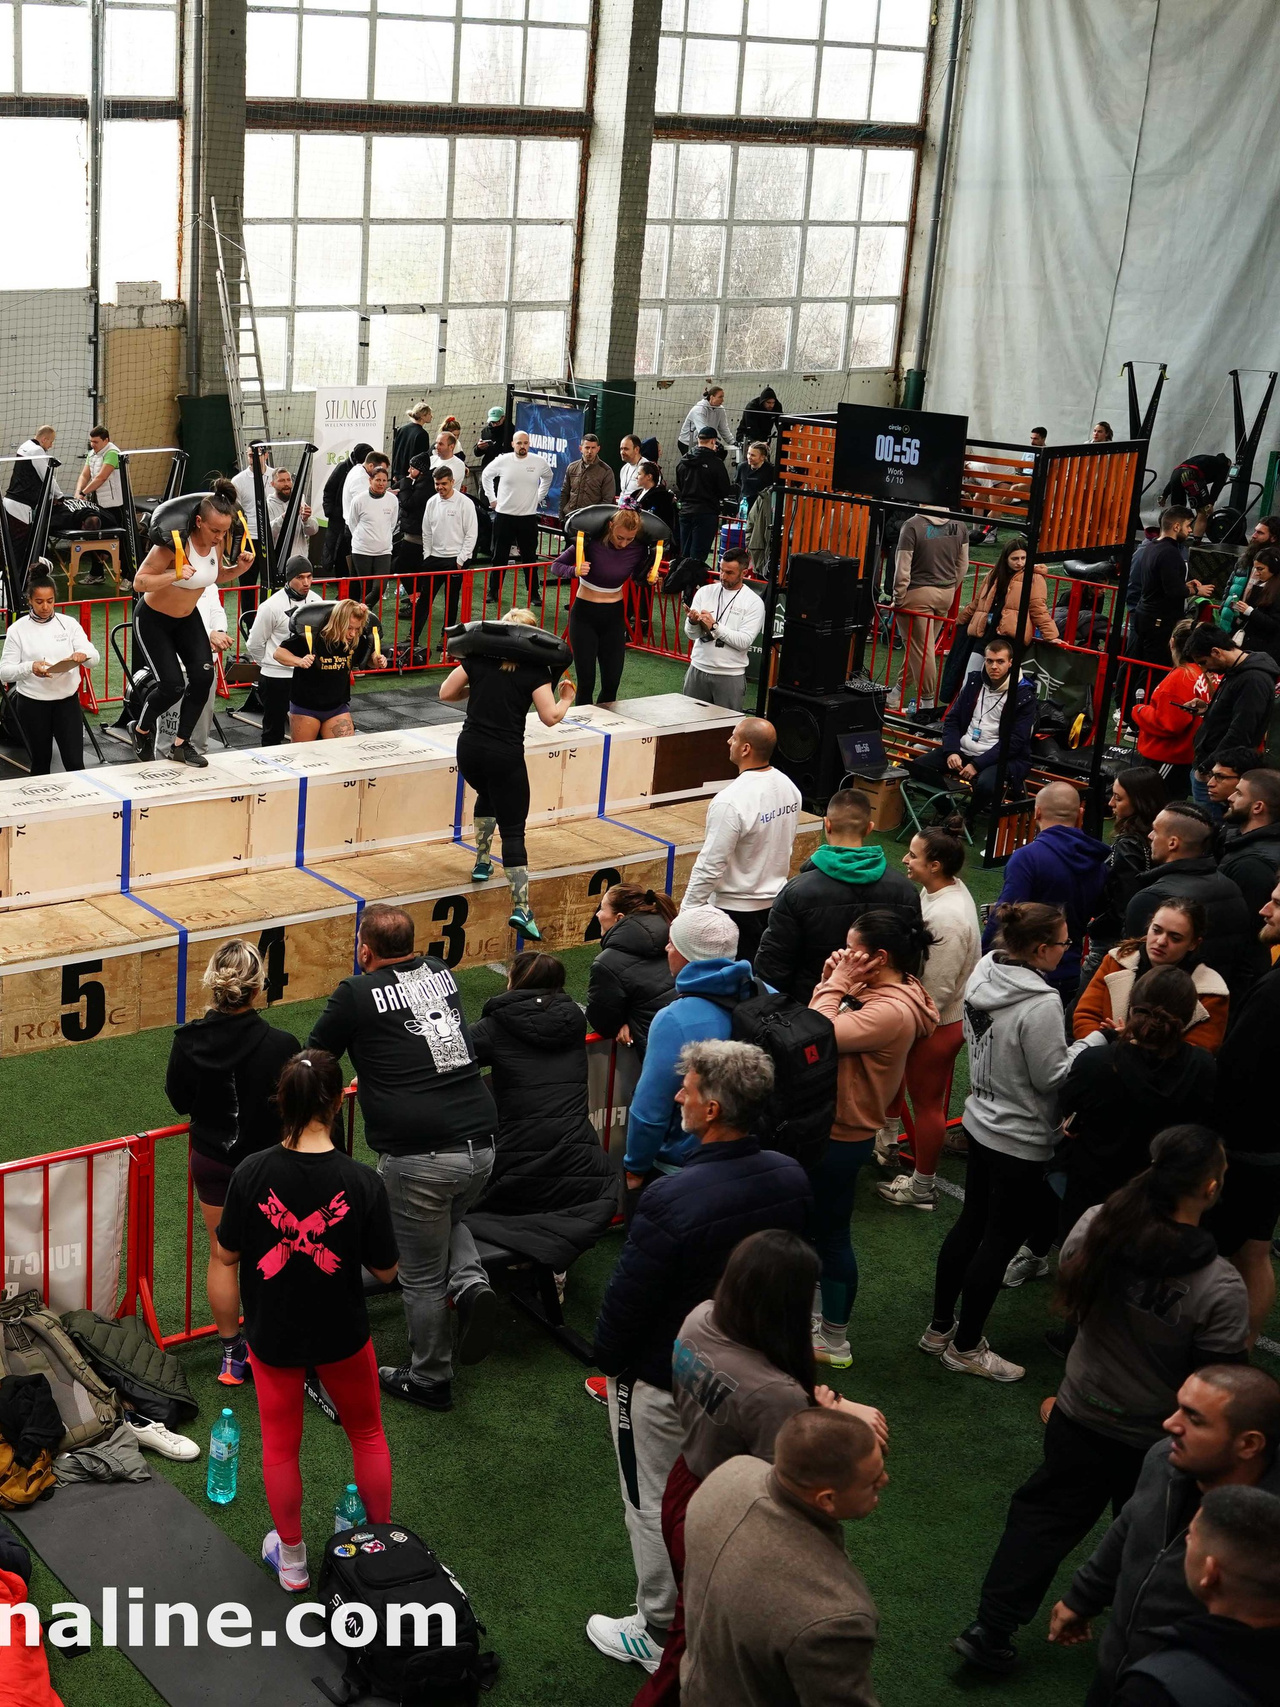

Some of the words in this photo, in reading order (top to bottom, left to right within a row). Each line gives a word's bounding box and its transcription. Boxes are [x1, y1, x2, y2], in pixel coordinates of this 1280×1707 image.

[529, 433, 554, 450] WARM
[556, 436, 568, 452] UP
[875, 434, 920, 466] 00:56
[327, 451, 350, 466] Rel
[887, 467, 904, 476] Work
[896, 476, 904, 485] 10
[747, 645, 763, 653] ETA
[548, 750, 561, 759] 50
[250, 765, 299, 777] METL
[133, 780, 187, 791] METAL
[188, 775, 218, 784] ART
[12, 796, 67, 807] METAL
[70, 791, 102, 800] ART
[777, 802, 798, 817] JUDGE
[584, 868, 622, 942] 2
[427, 895, 469, 969] 3
[60, 959, 106, 1042] 5
[13, 1006, 127, 1043] ROE
